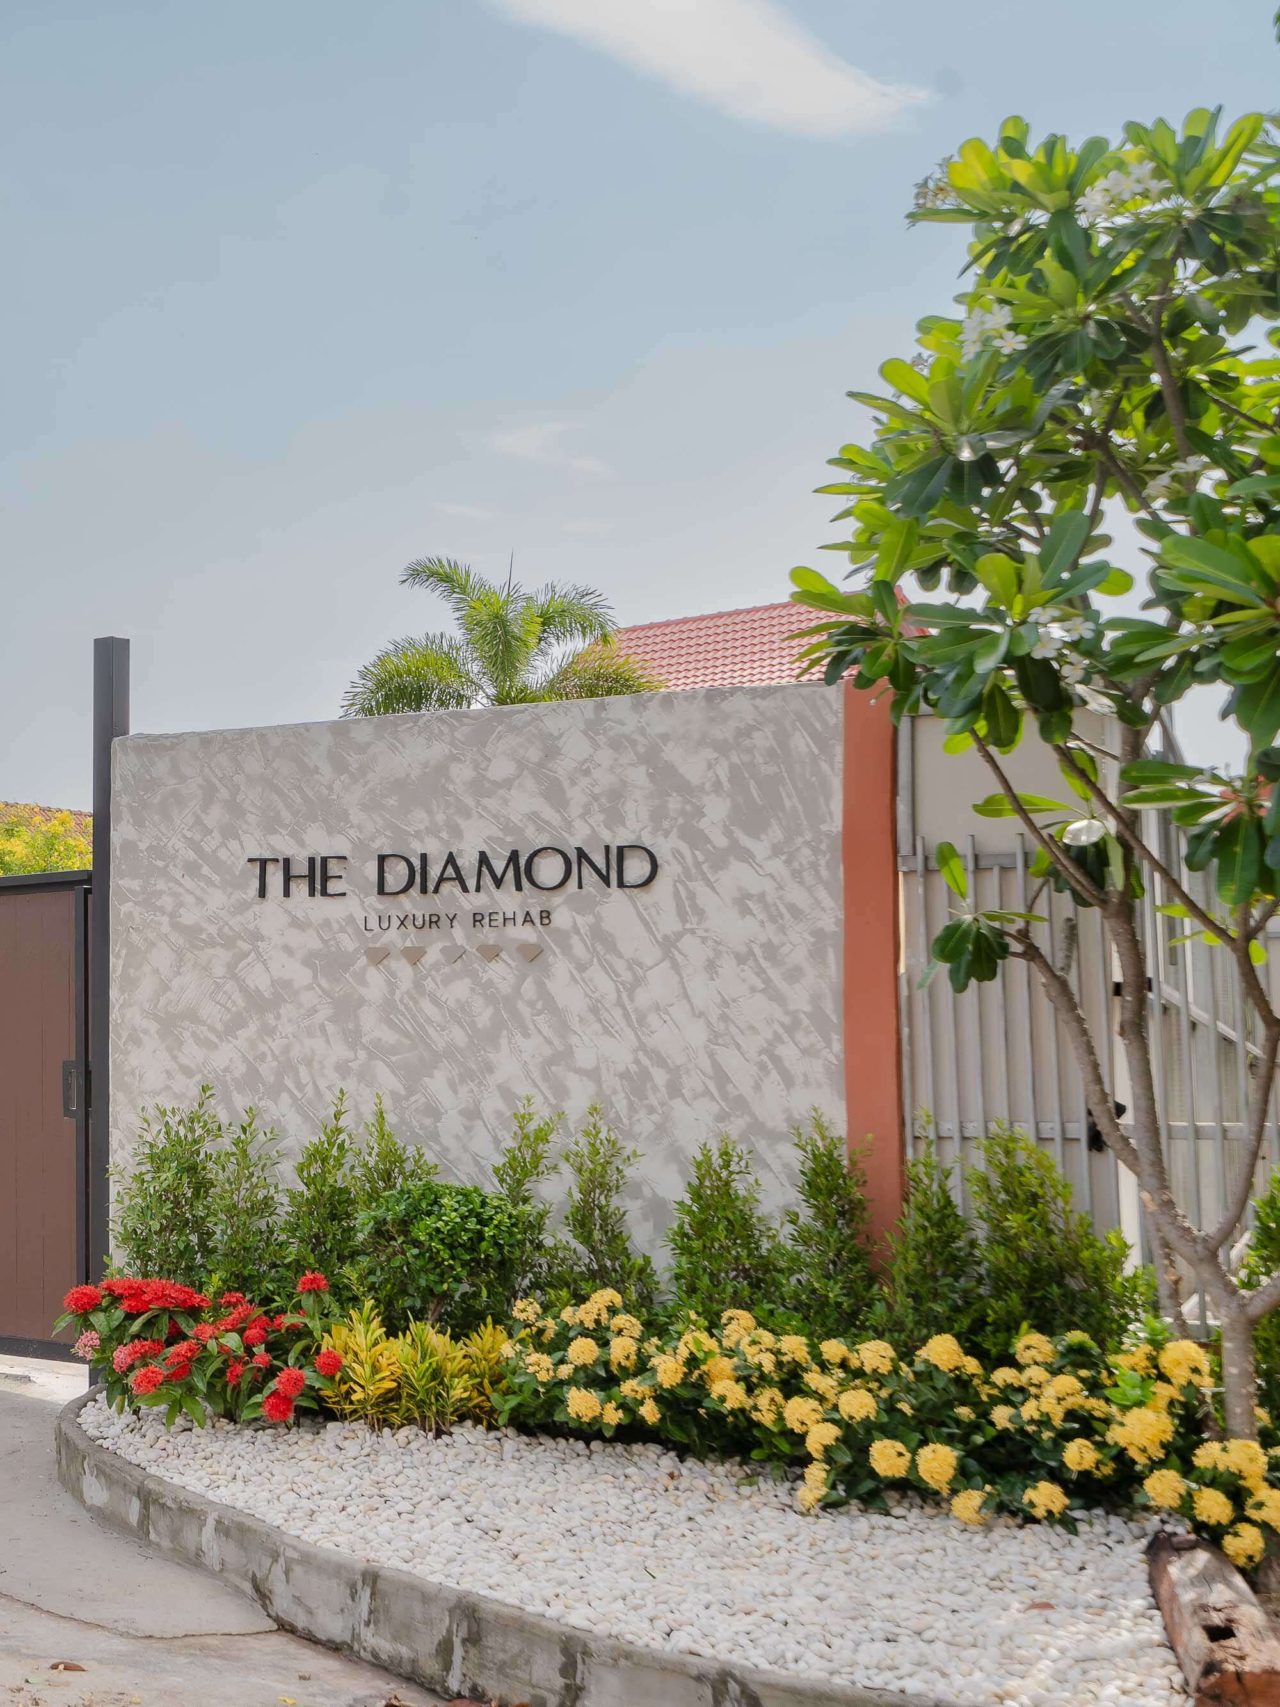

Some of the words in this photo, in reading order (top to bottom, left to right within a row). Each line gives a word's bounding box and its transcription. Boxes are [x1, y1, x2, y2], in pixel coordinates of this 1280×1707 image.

[247, 855, 348, 898] THE
[377, 844, 659, 896] DIAMOND
[363, 912, 459, 932] LUXURY
[472, 910, 552, 929] REHAB
